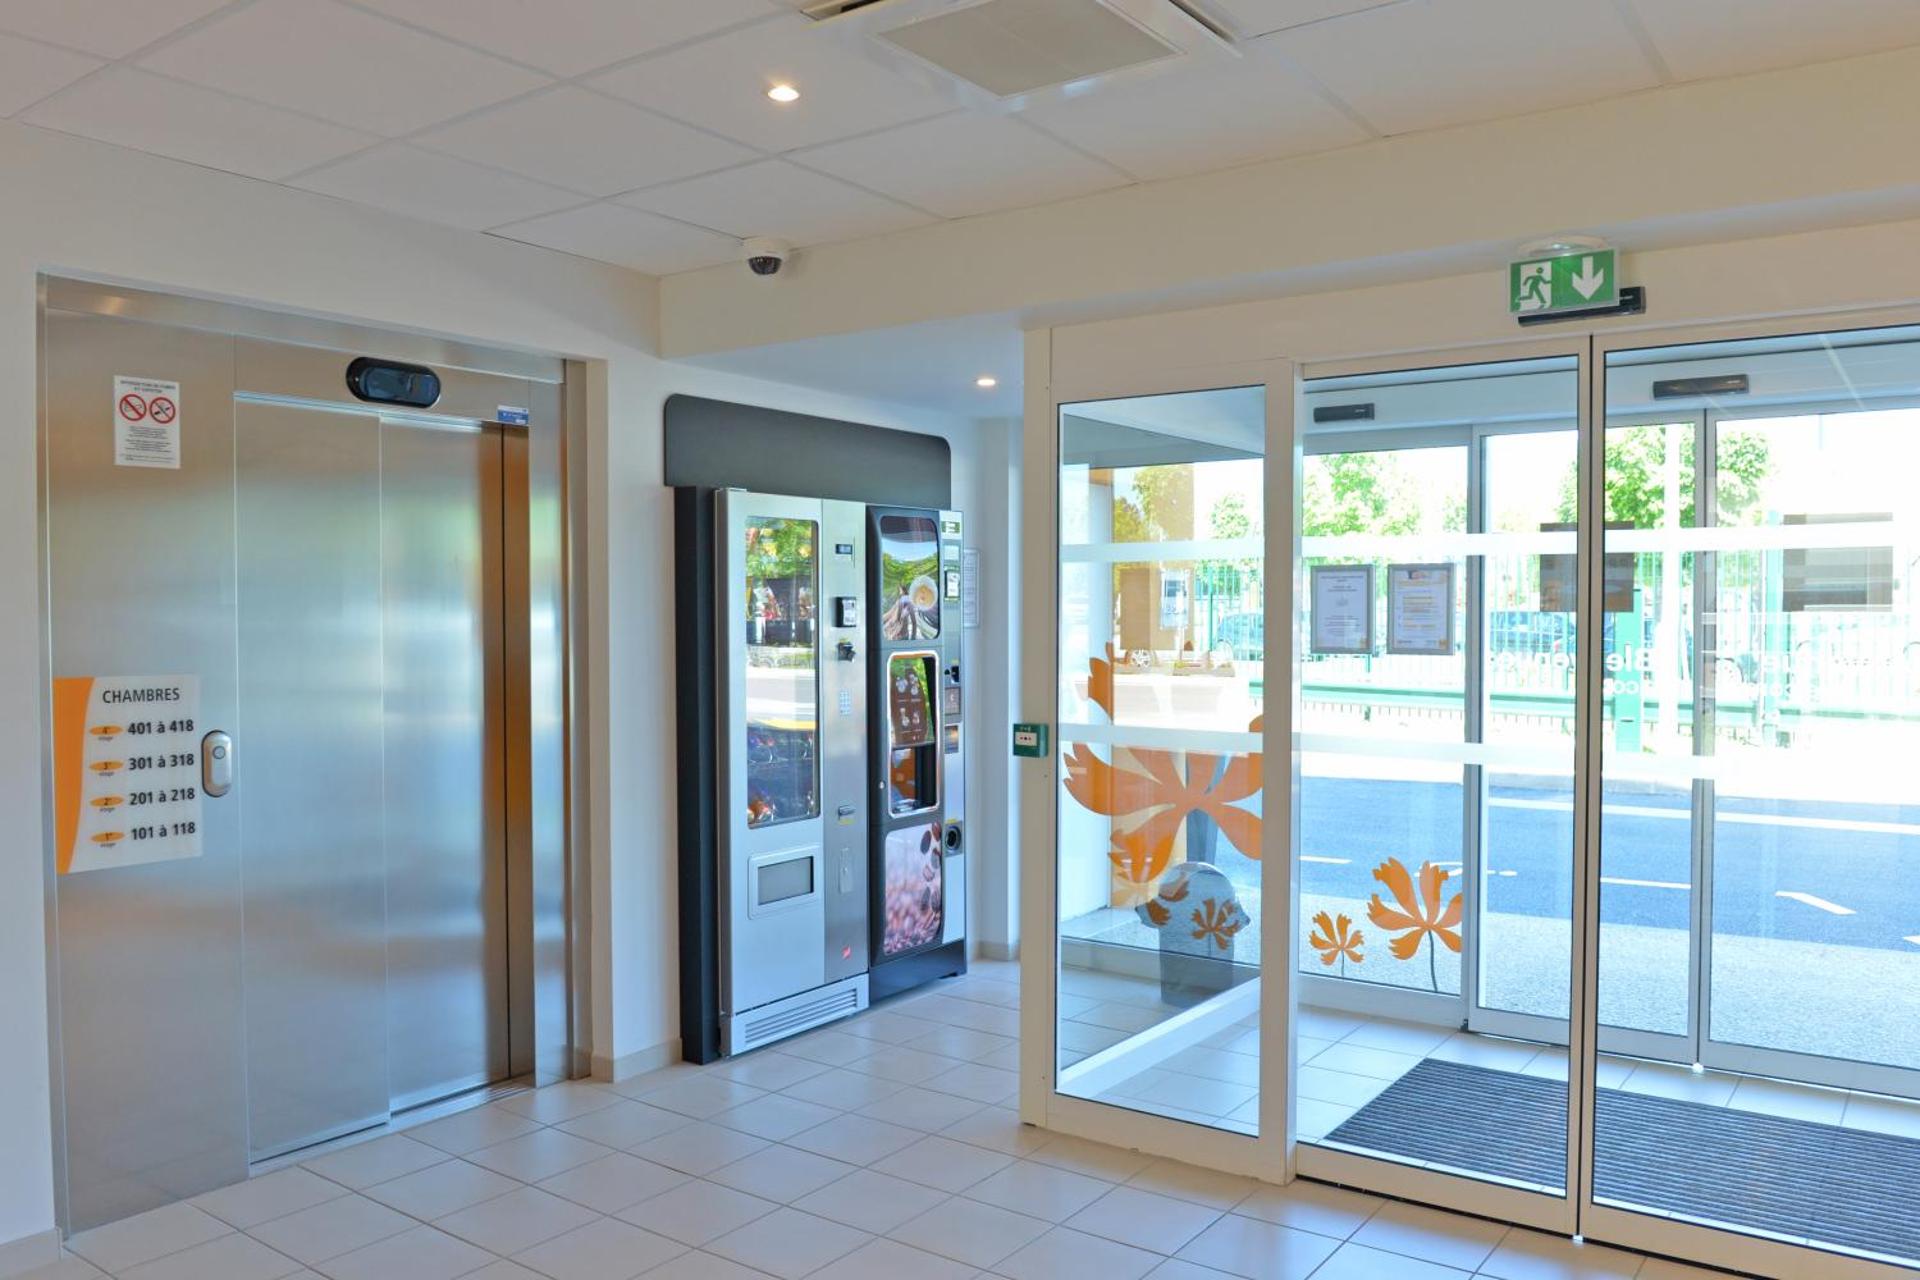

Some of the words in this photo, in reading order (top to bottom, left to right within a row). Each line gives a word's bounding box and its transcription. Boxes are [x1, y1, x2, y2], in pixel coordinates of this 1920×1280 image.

[103, 687, 180, 704] CHAMBRES
[128, 722, 152, 735] 401
[157, 720, 166, 734] à
[169, 719, 194, 732] 418
[129, 757, 152, 770] 301
[158, 755, 166, 769] à
[171, 753, 194, 767] 318
[130, 792, 153, 806] 201
[159, 790, 167, 804] à
[171, 788, 195, 802] 218
[132, 827, 154, 840] 101
[159, 825, 168, 838] à
[173, 822, 195, 835] 118
